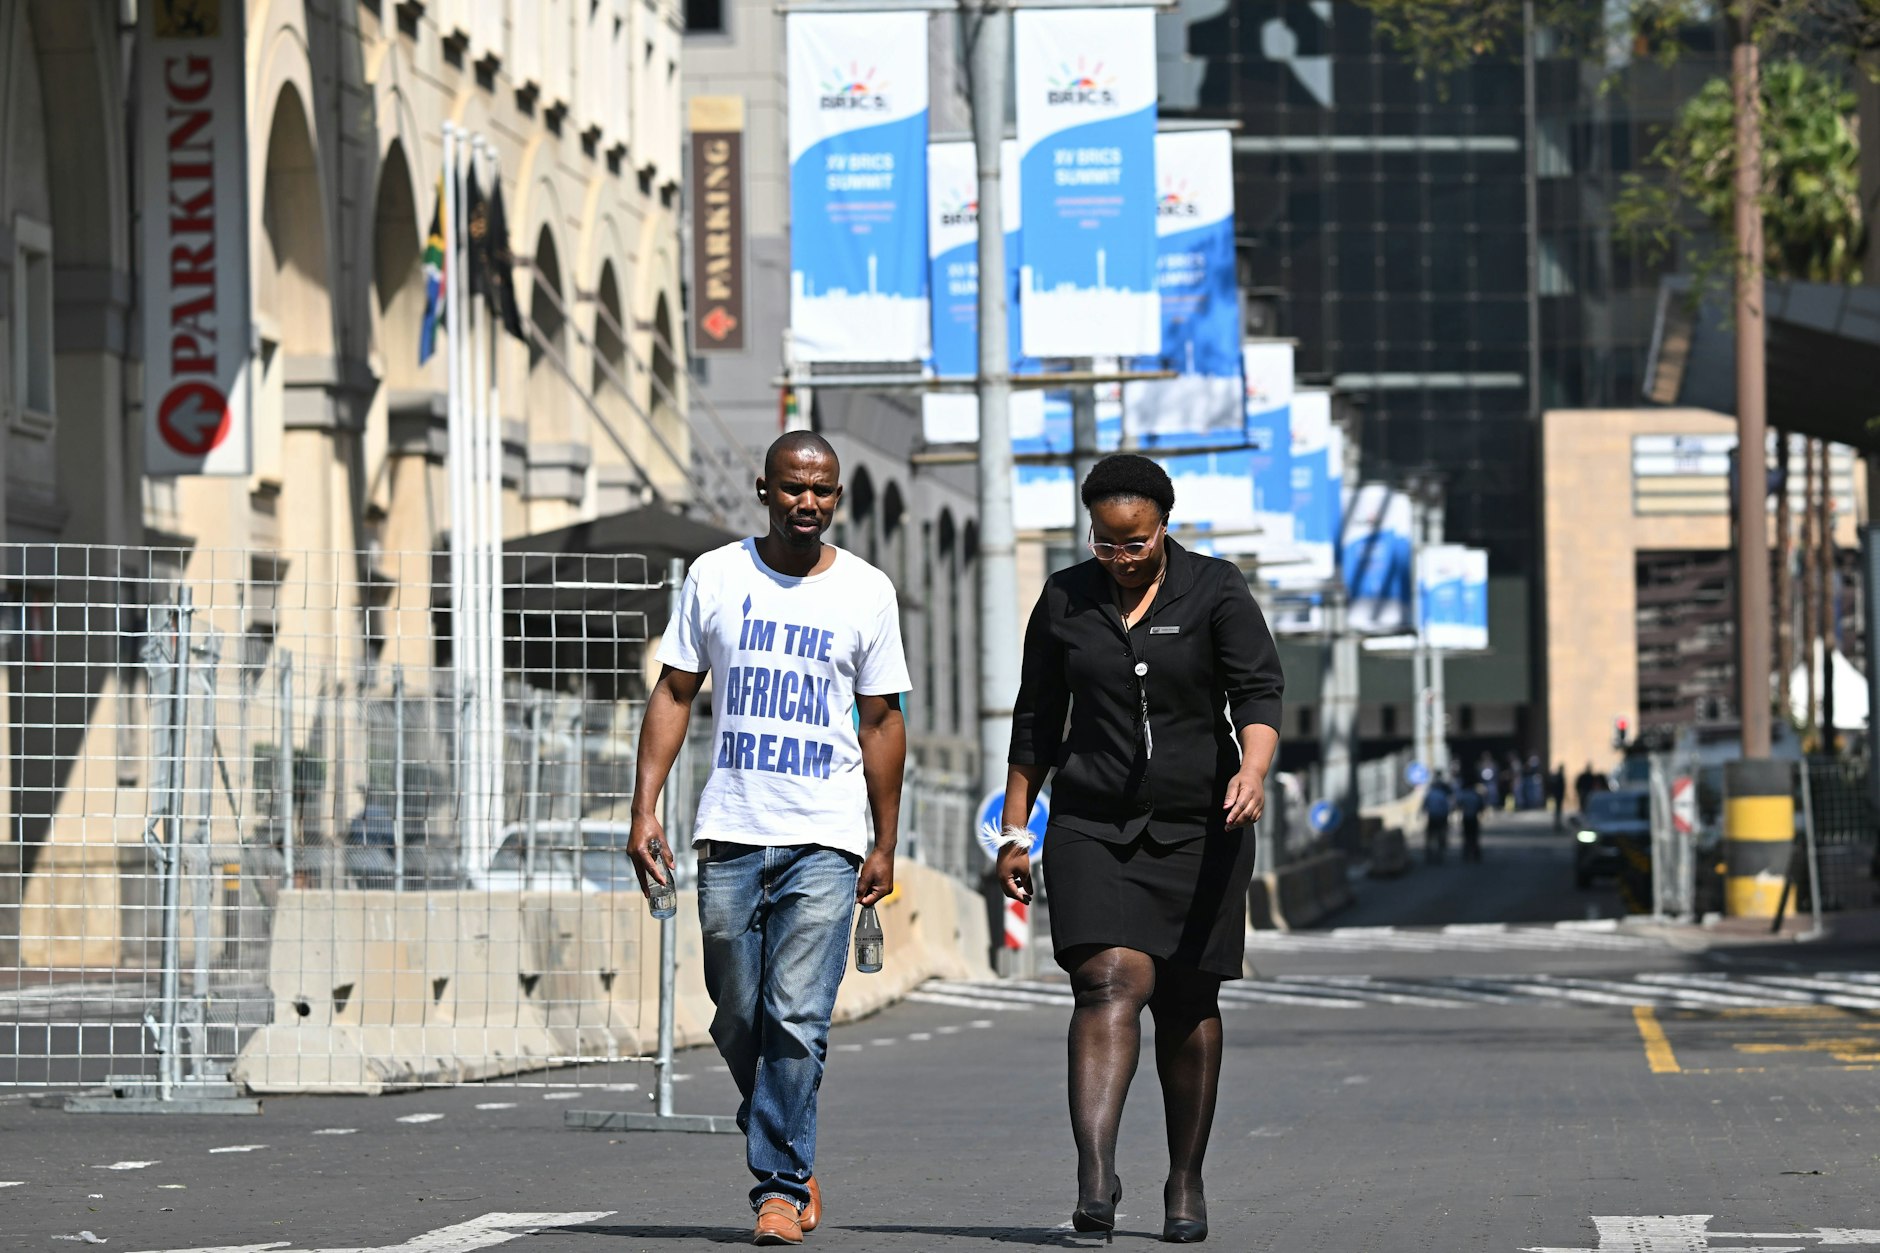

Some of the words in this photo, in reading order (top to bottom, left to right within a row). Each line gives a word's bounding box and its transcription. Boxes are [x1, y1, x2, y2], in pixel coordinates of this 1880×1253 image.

[819, 96, 889, 110] BRICS
[1047, 90, 1117, 105] BRICS
[826, 153, 846, 171] XV
[848, 152, 895, 171] BRICS
[1054, 149, 1073, 167] XV
[1076, 147, 1122, 166] BRICS
[826, 173, 895, 191] SUMMIT
[1054, 167, 1122, 186] SUMMIT
[164, 55, 218, 378] PARKING
[702, 139, 731, 299] PARKING
[784, 624, 835, 663] THE
[726, 666, 831, 727] AFRICAN
[717, 731, 834, 780] DREAM
